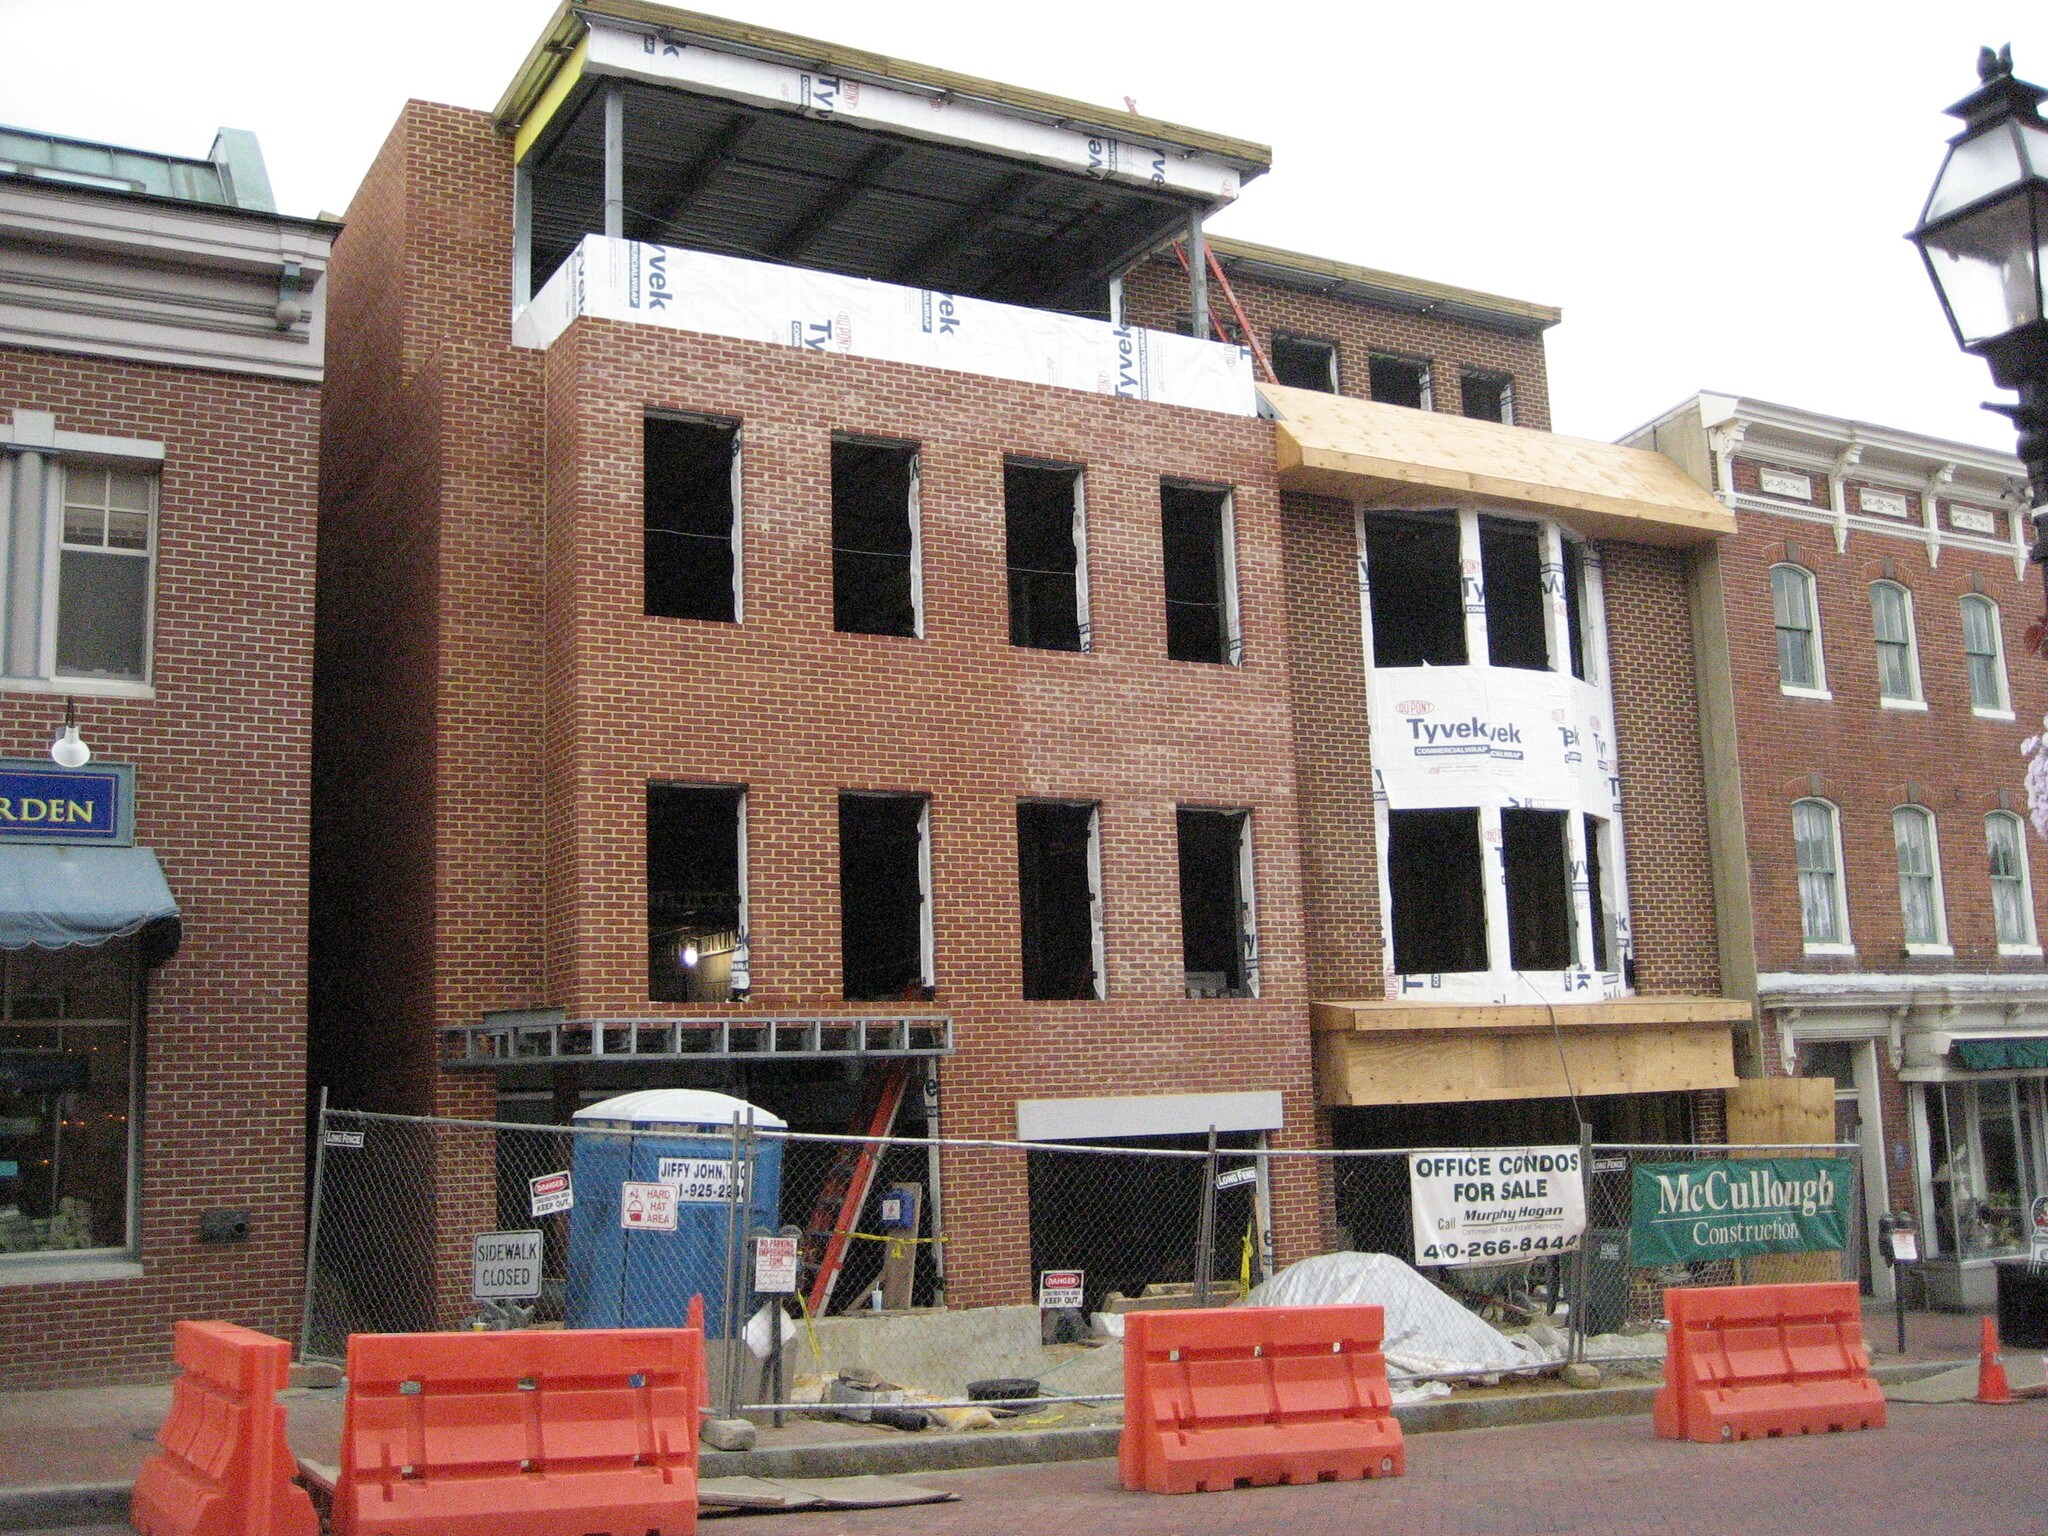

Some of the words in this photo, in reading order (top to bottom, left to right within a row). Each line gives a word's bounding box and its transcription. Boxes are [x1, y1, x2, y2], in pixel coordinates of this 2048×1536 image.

[1406, 716, 1489, 744] Tyvek
[1415, 746, 1488, 756] COMMERCIALWRAP
[0, 797, 95, 823] RDEN
[661, 1163, 690, 1178] JIFFY
[1416, 1157, 1491, 1178] OFFICE
[1499, 1153, 1579, 1176] CONDOS
[537, 1179, 565, 1192] DANGER
[1218, 1173, 1238, 1186] LONG
[1238, 1168, 1256, 1180] FENCE
[647, 1190, 671, 1200] HARD
[1454, 1182, 1495, 1202] FOR
[1501, 1179, 1548, 1200] SALE
[1657, 1169, 1835, 1217] McCullough
[537, 1203, 553, 1212] KEEP
[556, 1199, 569, 1208] OUT
[650, 1202, 666, 1212] HAT
[646, 1214, 670, 1224] AREA
[1438, 1218, 1456, 1230] Call
[1464, 1208, 1516, 1224] Murphy
[1519, 1206, 1563, 1220] Hogan
[1534, 1222, 1562, 1230] Services
[1692, 1217, 1800, 1247] Construction
[478, 1243, 537, 1261] SIDEWALK
[482, 1268, 530, 1286] CLOSED
[1048, 1277, 1076, 1285] DANGER
